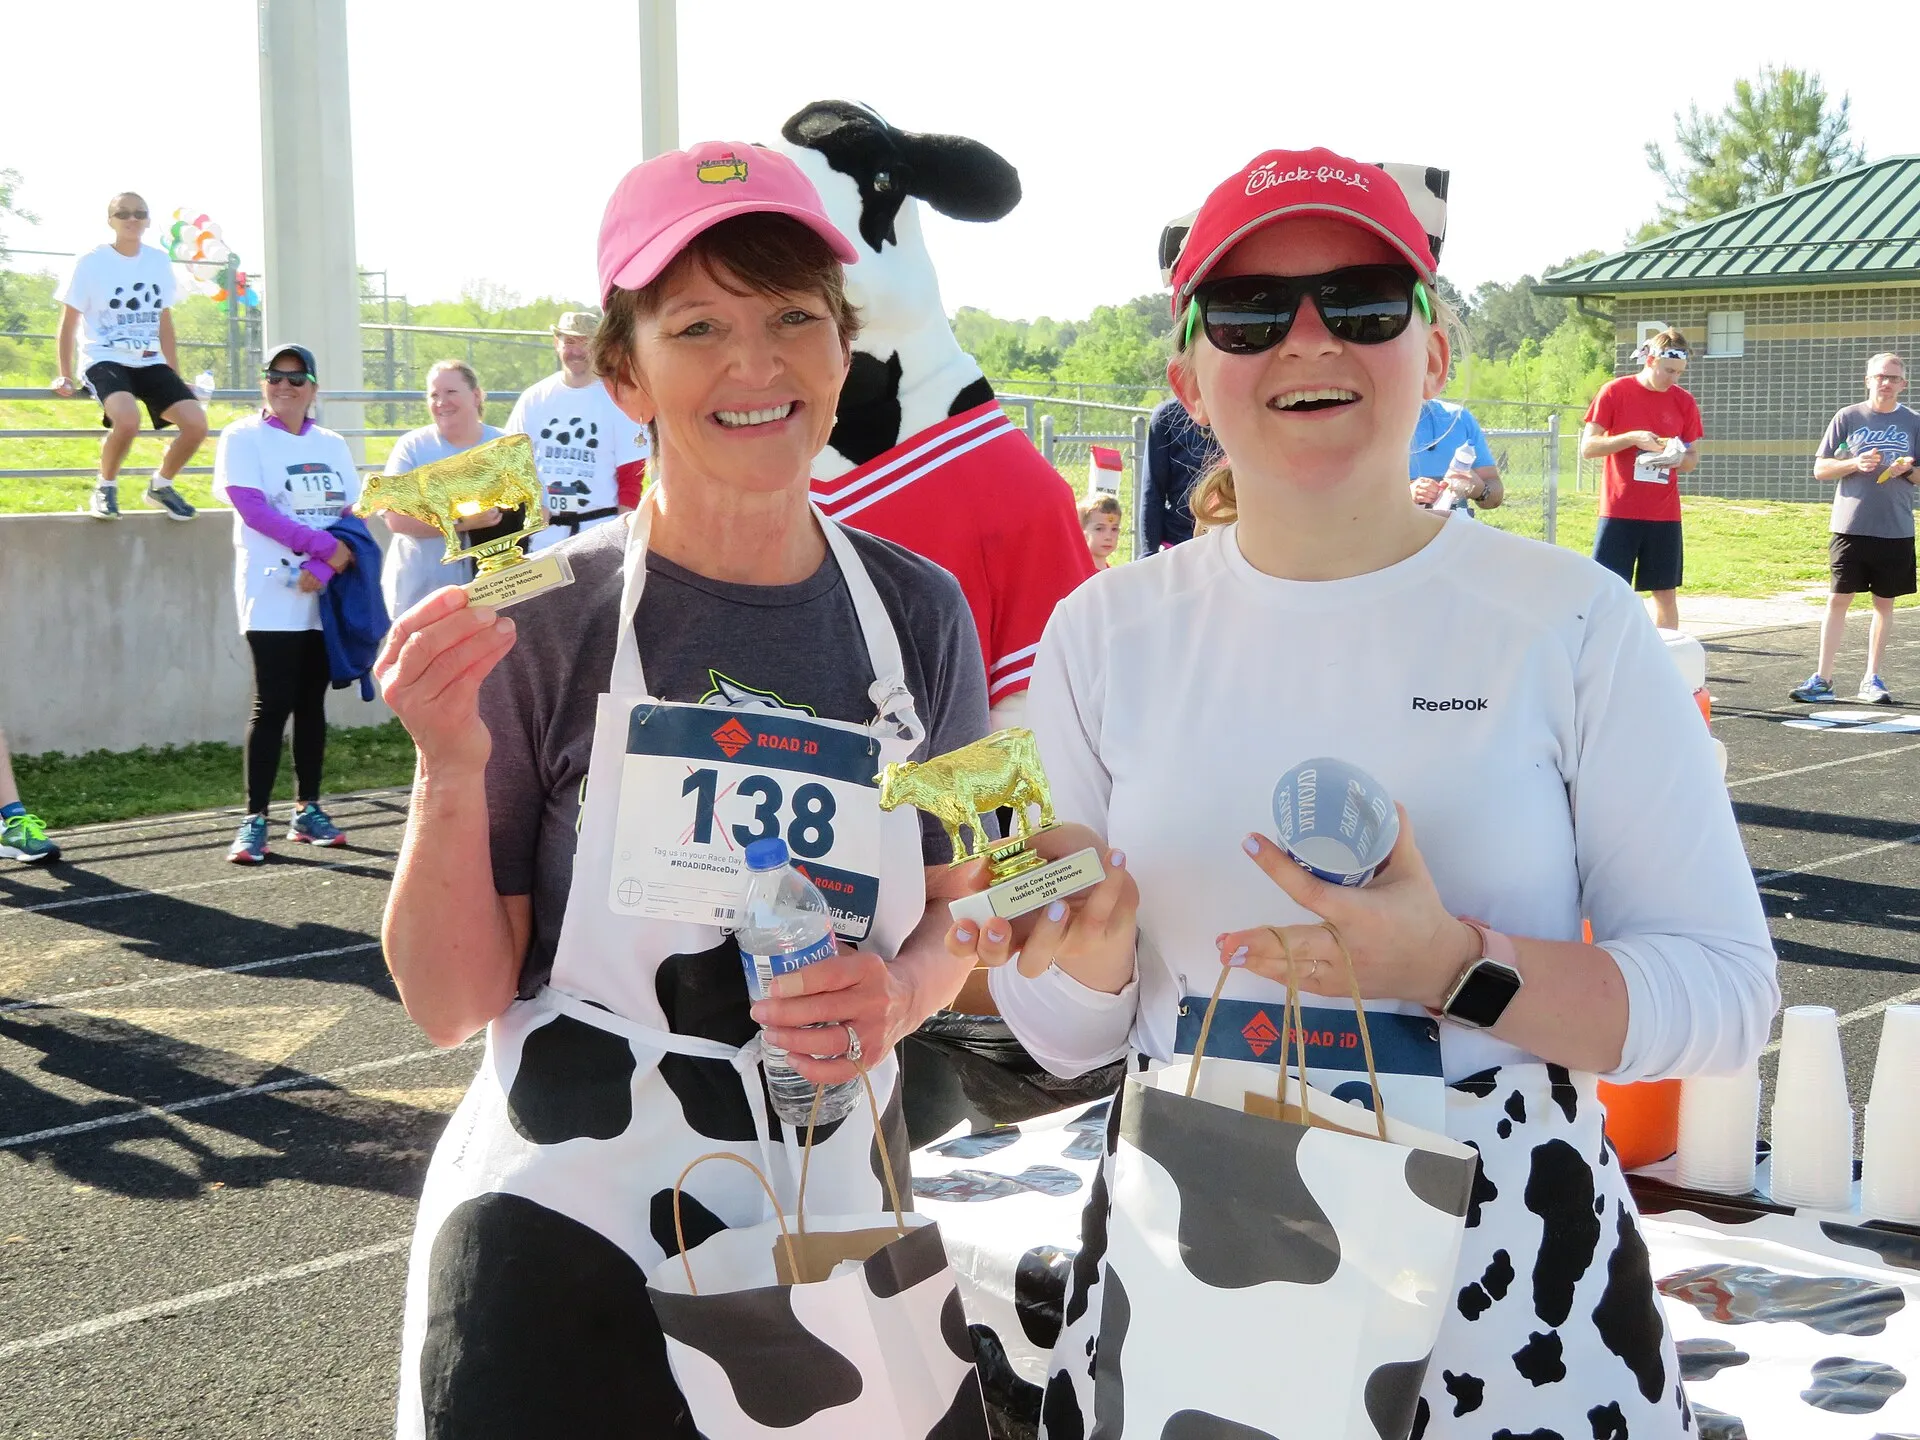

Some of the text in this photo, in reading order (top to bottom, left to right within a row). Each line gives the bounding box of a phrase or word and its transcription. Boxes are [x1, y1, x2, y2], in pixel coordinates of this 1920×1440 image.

[1848, 424, 1909, 449] Duke
[302, 474, 332, 492] 118
[550, 496, 568, 510] 08
[469, 591, 494, 602] Huskies
[505, 582, 515, 590] the
[516, 573, 543, 586] Mooove
[474, 569, 532, 593] Best Cow Costume
[501, 590, 517, 599] 2018
[1412, 697, 1488, 711] Reebok
[757, 733, 819, 755] ROAD iD
[682, 768, 837, 858] 138
[653, 847, 667, 857] Tag
[689, 851, 707, 860] your
[708, 853, 726, 862] Race
[728, 855, 742, 866] Day
[670, 860, 739, 876] #ROADiDRaceDay
[815, 877, 841, 891] ROAD
[1010, 868, 1083, 903] Huskies on the Mooove
[1014, 865, 1072, 892] Best Cow Costume
[1041, 887, 1058, 898] 2018
[829, 906, 844, 918] ift
[846, 911, 870, 924] Card
[833, 921, 847, 930] K65
[783, 938, 837, 972] DIAMON
[1287, 1028, 1358, 1049] ROAD iD
